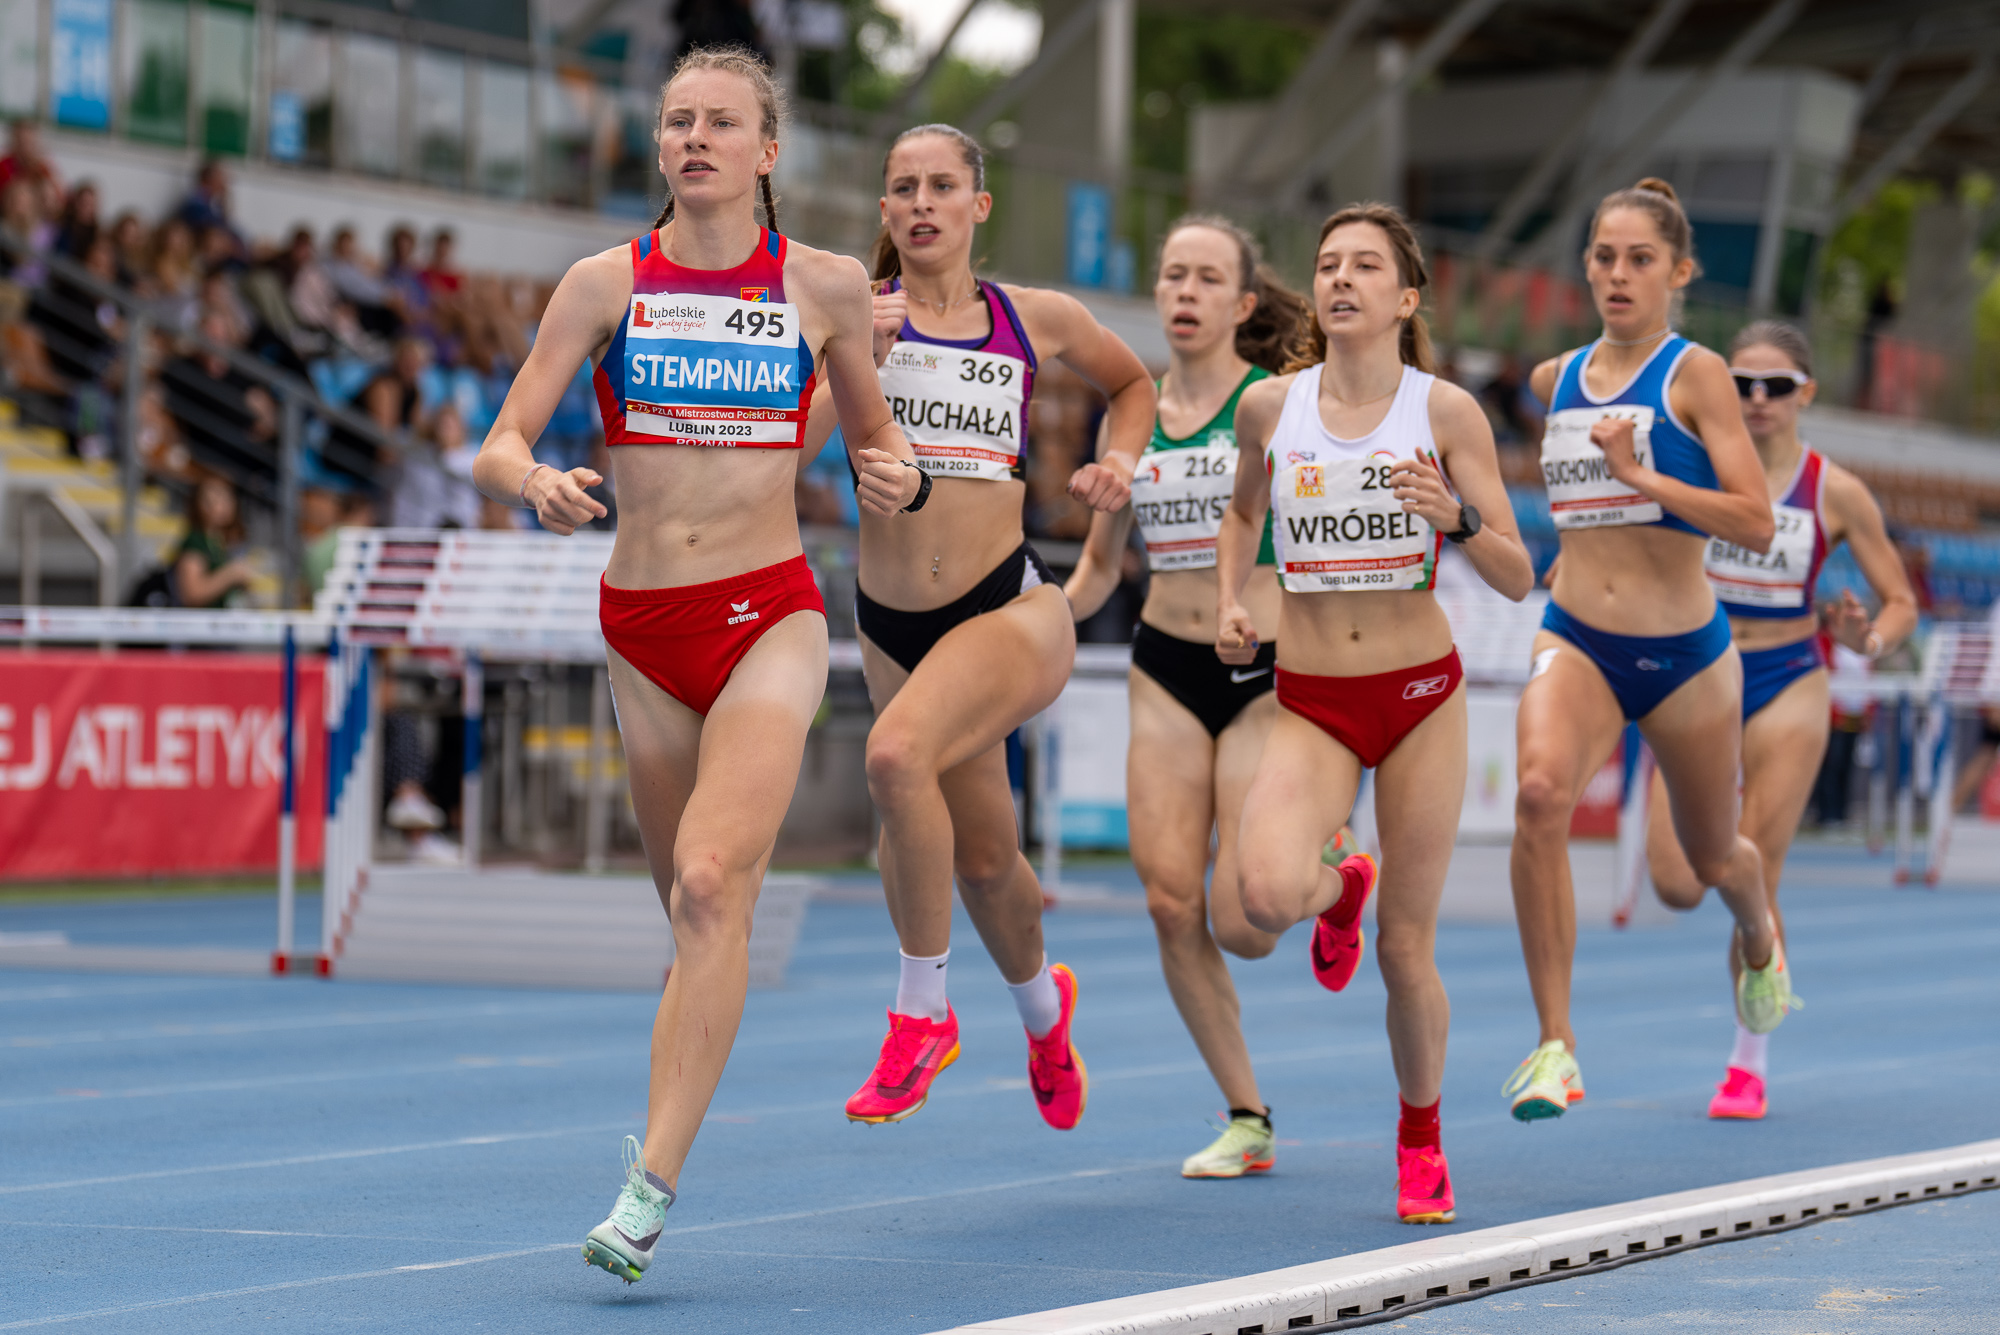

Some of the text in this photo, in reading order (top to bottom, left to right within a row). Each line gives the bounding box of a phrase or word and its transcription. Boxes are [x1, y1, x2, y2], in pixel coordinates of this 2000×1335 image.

[656, 319, 682, 333] Smakuj
[725, 309, 784, 338] 495
[631, 353, 792, 393] STEMPNIAK
[959, 358, 1013, 387] 369
[651, 406, 674, 416] PZLA
[675, 408, 735, 419] Mistrzostwa
[737, 410, 765, 420] Polski
[767, 411, 786, 420] U20
[885, 395, 1014, 439] RUCHAŁA
[669, 421, 752, 436] LUBLIN 2023
[965, 448, 990, 459] Polski
[917, 460, 979, 471] BLIN 2023
[1185, 456, 1227, 478] 216
[1361, 466, 1393, 491] 28
[1288, 508, 1418, 544] WRÓBEL
[1324, 560, 1377, 570] Mistrzostwa
[1320, 573, 1393, 585] LUBLIN 2023
[728, 611, 759, 625] erima
